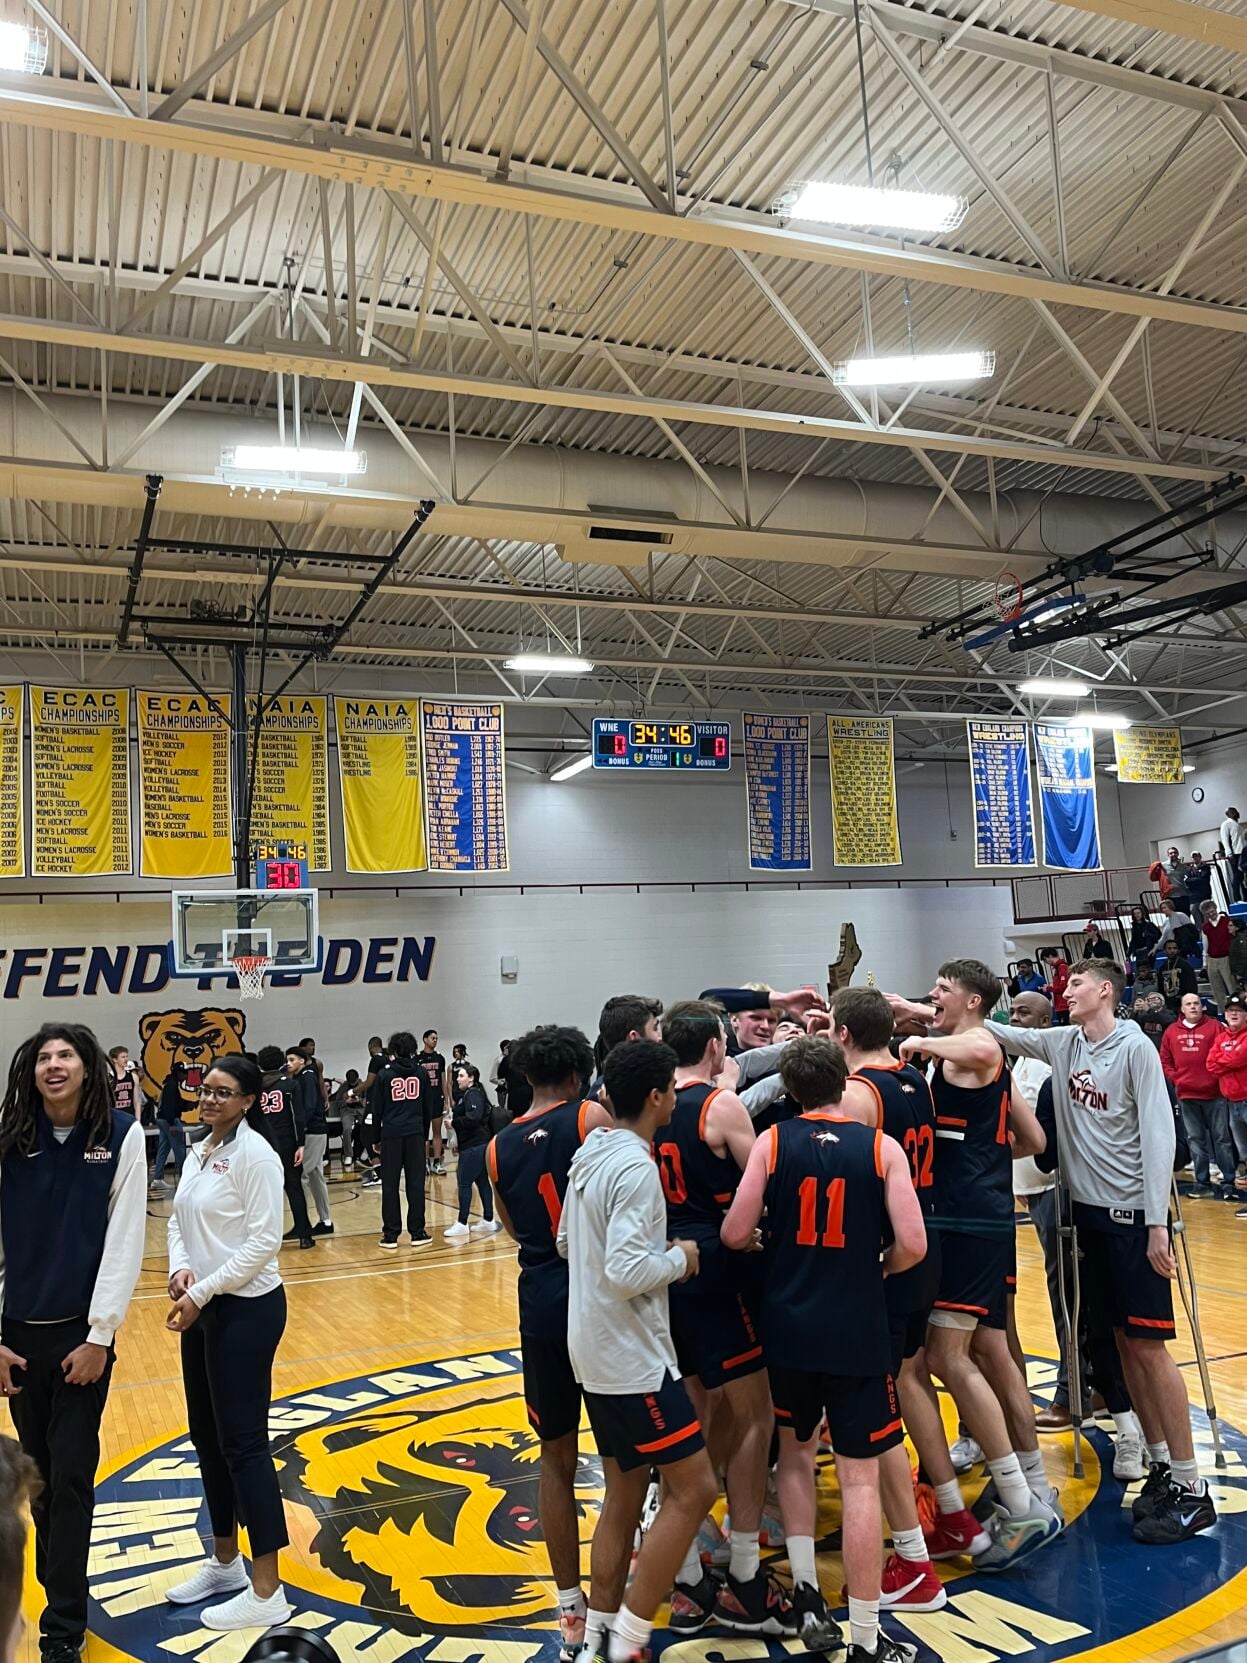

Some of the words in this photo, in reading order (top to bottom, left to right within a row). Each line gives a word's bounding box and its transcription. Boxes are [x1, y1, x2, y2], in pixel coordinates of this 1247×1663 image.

[43, 691, 116, 707] ECAC
[147, 698, 221, 712] ECAC
[346, 703, 408, 716] NAIA
[40, 708, 120, 722] CHAMPIONSHIPS
[453, 706, 493, 717] BASKETBALL
[146, 713, 223, 728] CHAMPIONSHIPS
[345, 717, 411, 730] CHAMPIONSHIPS
[452, 717, 475, 730] POINT
[479, 717, 499, 730] CLUB
[61, 727, 100, 735] BASKETBALL
[600, 722, 618, 732] WNE
[697, 725, 728, 735] VISITOR
[790, 727, 807, 739] CLUB
[833, 728, 889, 736] WRESTLING
[35, 735, 64, 743] SOFTBALL
[142, 731, 179, 740] VOLLEYBALL
[261, 734, 297, 742] BASKETBALL
[62, 745, 94, 753] LACROSSE
[614, 735, 626, 755] 0
[715, 737, 726, 757] 0
[35, 753, 64, 761] SOFTBALL
[154, 750, 176, 758] HOCKEY
[143, 758, 172, 766] SOFTBALL
[608, 757, 629, 765] BONUS
[645, 753, 668, 761] PERIOD
[262, 760, 299, 768] BASKETBALL
[36, 772, 74, 780] VOLLEYBALL
[143, 776, 180, 784] VOLLEYBALL
[36, 781, 66, 789] SOFTBALL
[144, 785, 179, 793] VOLLEYBALL
[36, 790, 66, 798] FOOTBALL
[144, 803, 172, 811] BASEBALL
[48, 818, 71, 826] HOCKEY
[36, 827, 54, 835] MEN'S
[36, 836, 68, 844] SOFTBALL
[64, 846, 96, 854] LACROSSE
[260, 846, 276, 860] 34
[288, 846, 306, 860] 46
[36, 855, 75, 864] VOLLEYBALL
[36, 864, 45, 872] ICE
[47, 865, 72, 873] HOCKEY
[267, 863, 300, 888] 30
[0, 945, 170, 998] FEND
[322, 936, 435, 985] DEN
[391, 1076, 420, 1101] 20
[260, 1090, 284, 1114] 23
[84, 1151, 112, 1160] MILTON
[904, 1124, 934, 1190] 32
[650, 1142, 688, 1204] 0
[796, 1177, 846, 1248] 11
